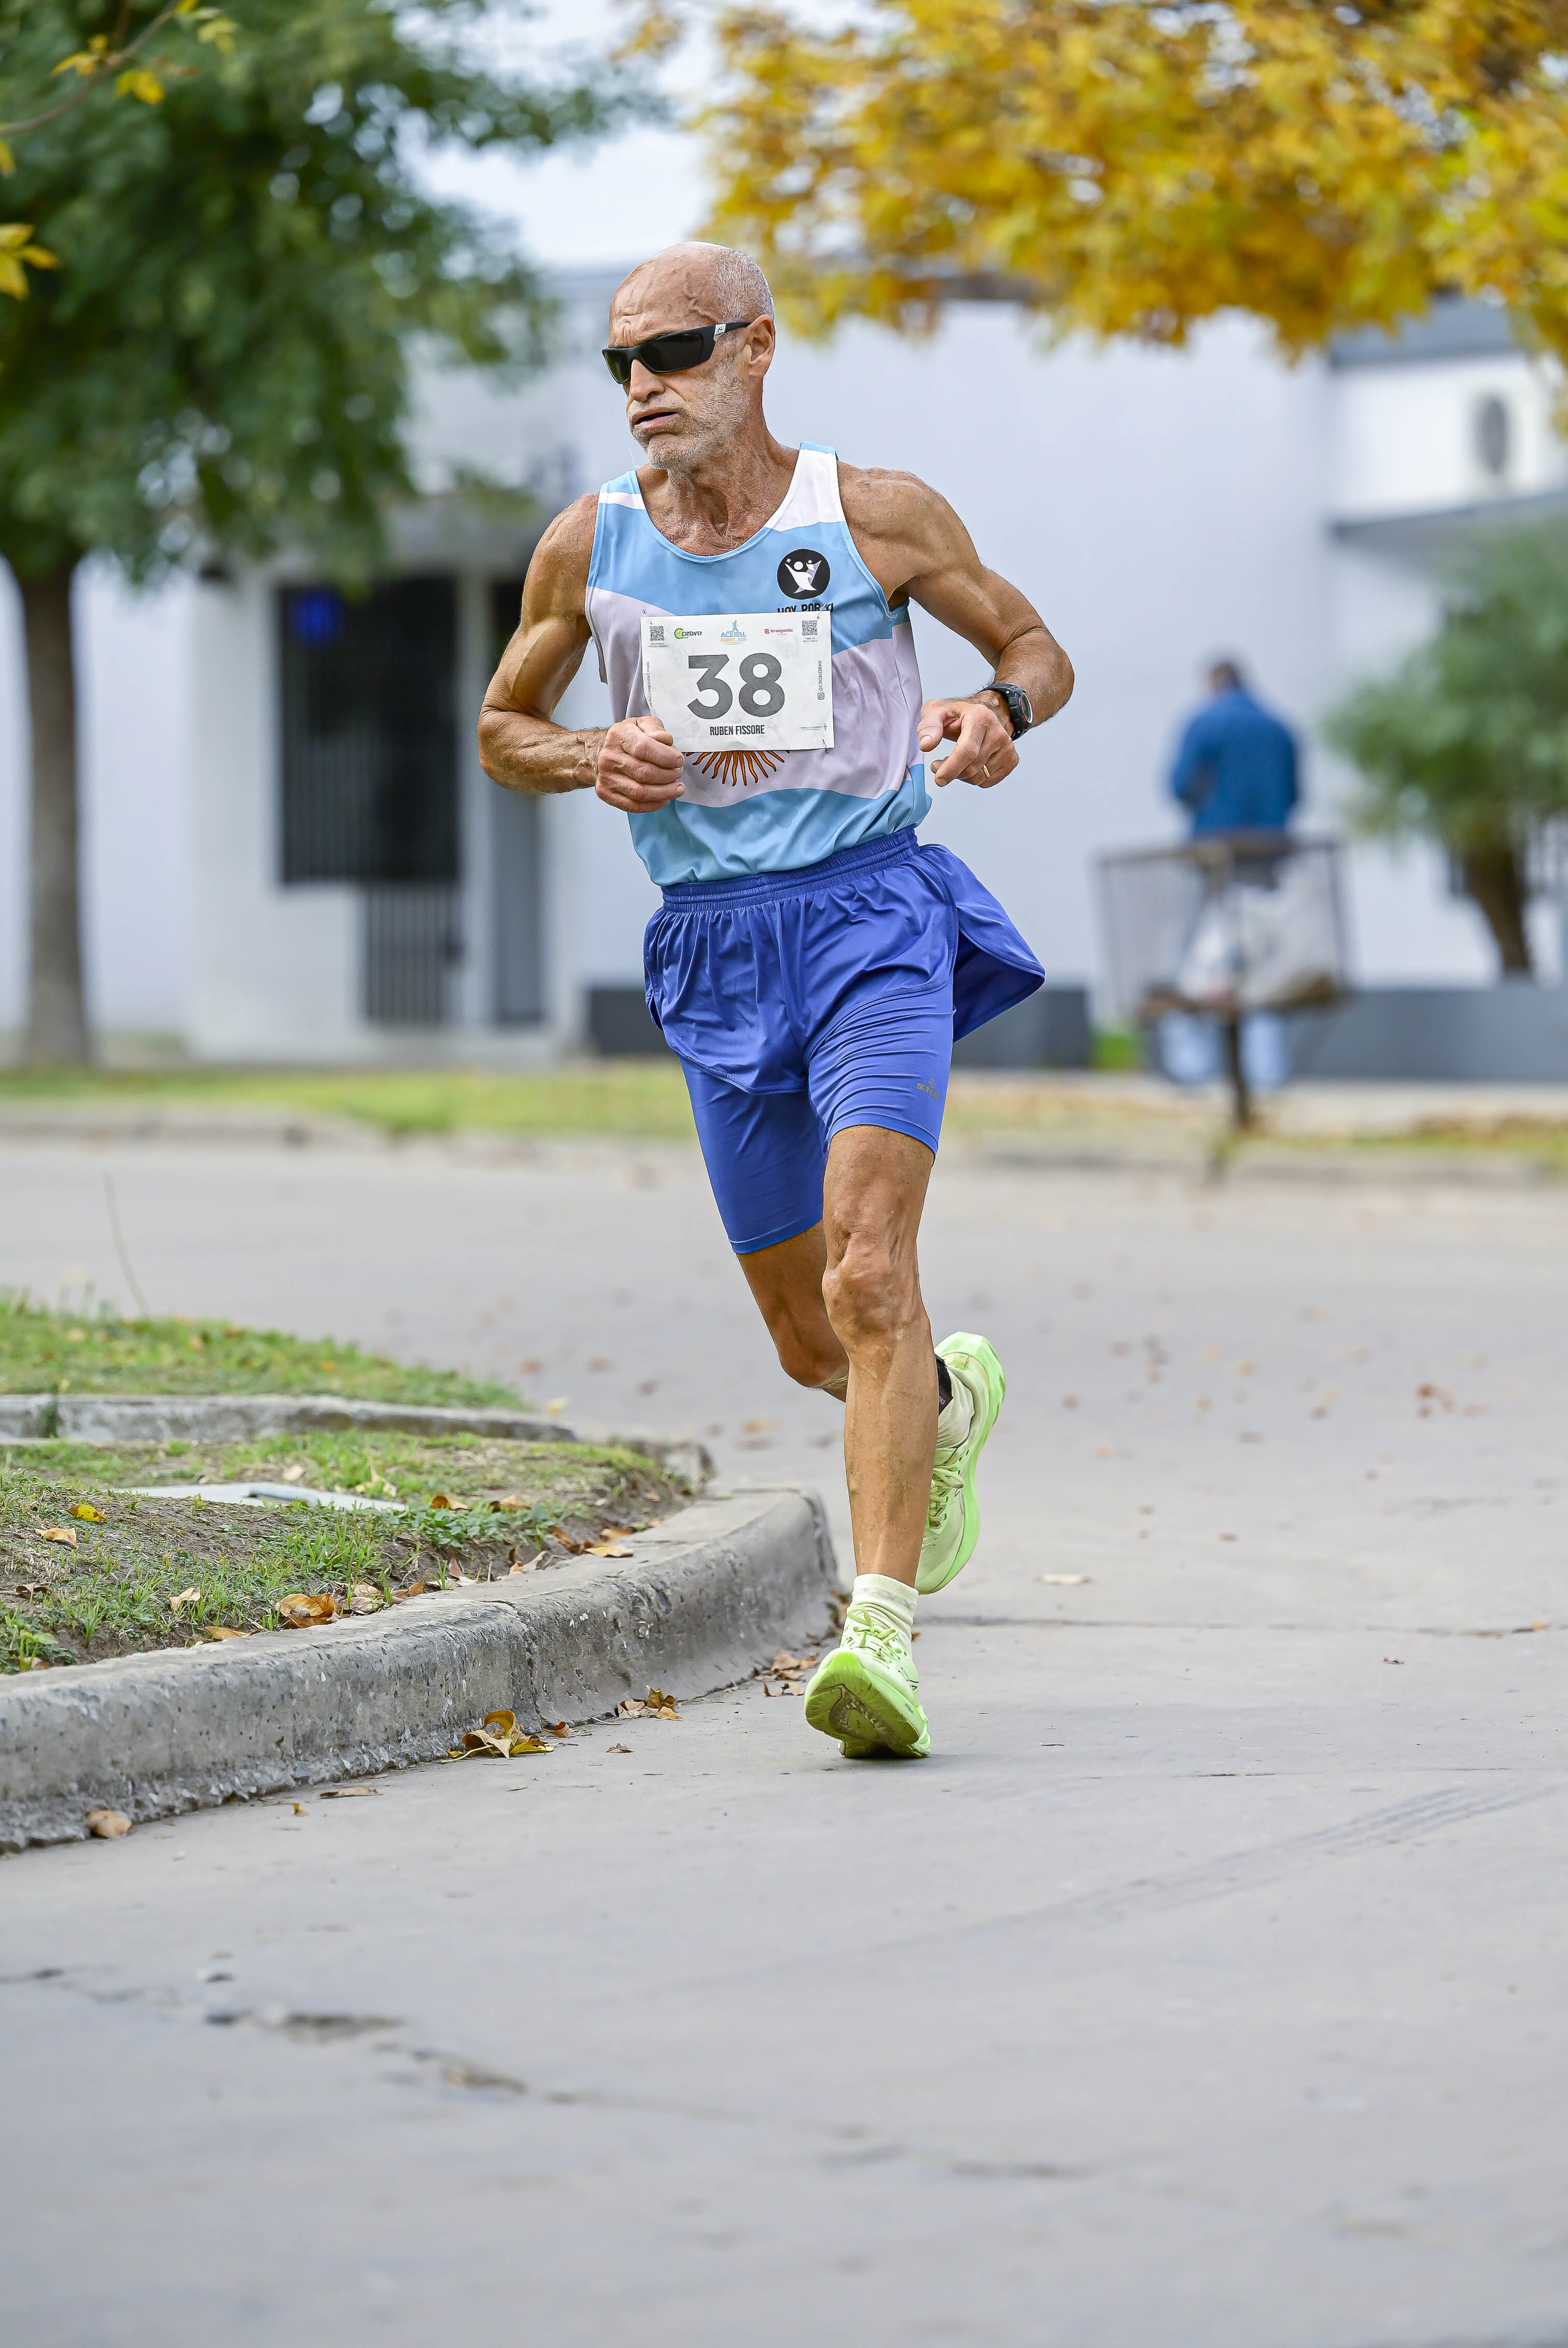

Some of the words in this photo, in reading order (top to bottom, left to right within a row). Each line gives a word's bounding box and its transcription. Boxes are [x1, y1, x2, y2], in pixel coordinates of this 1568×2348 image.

[801, 603, 821, 612] POR
[687, 652, 785, 719] 38
[709, 726, 734, 736] RUBEN
[735, 724, 765, 735] FISSORE
